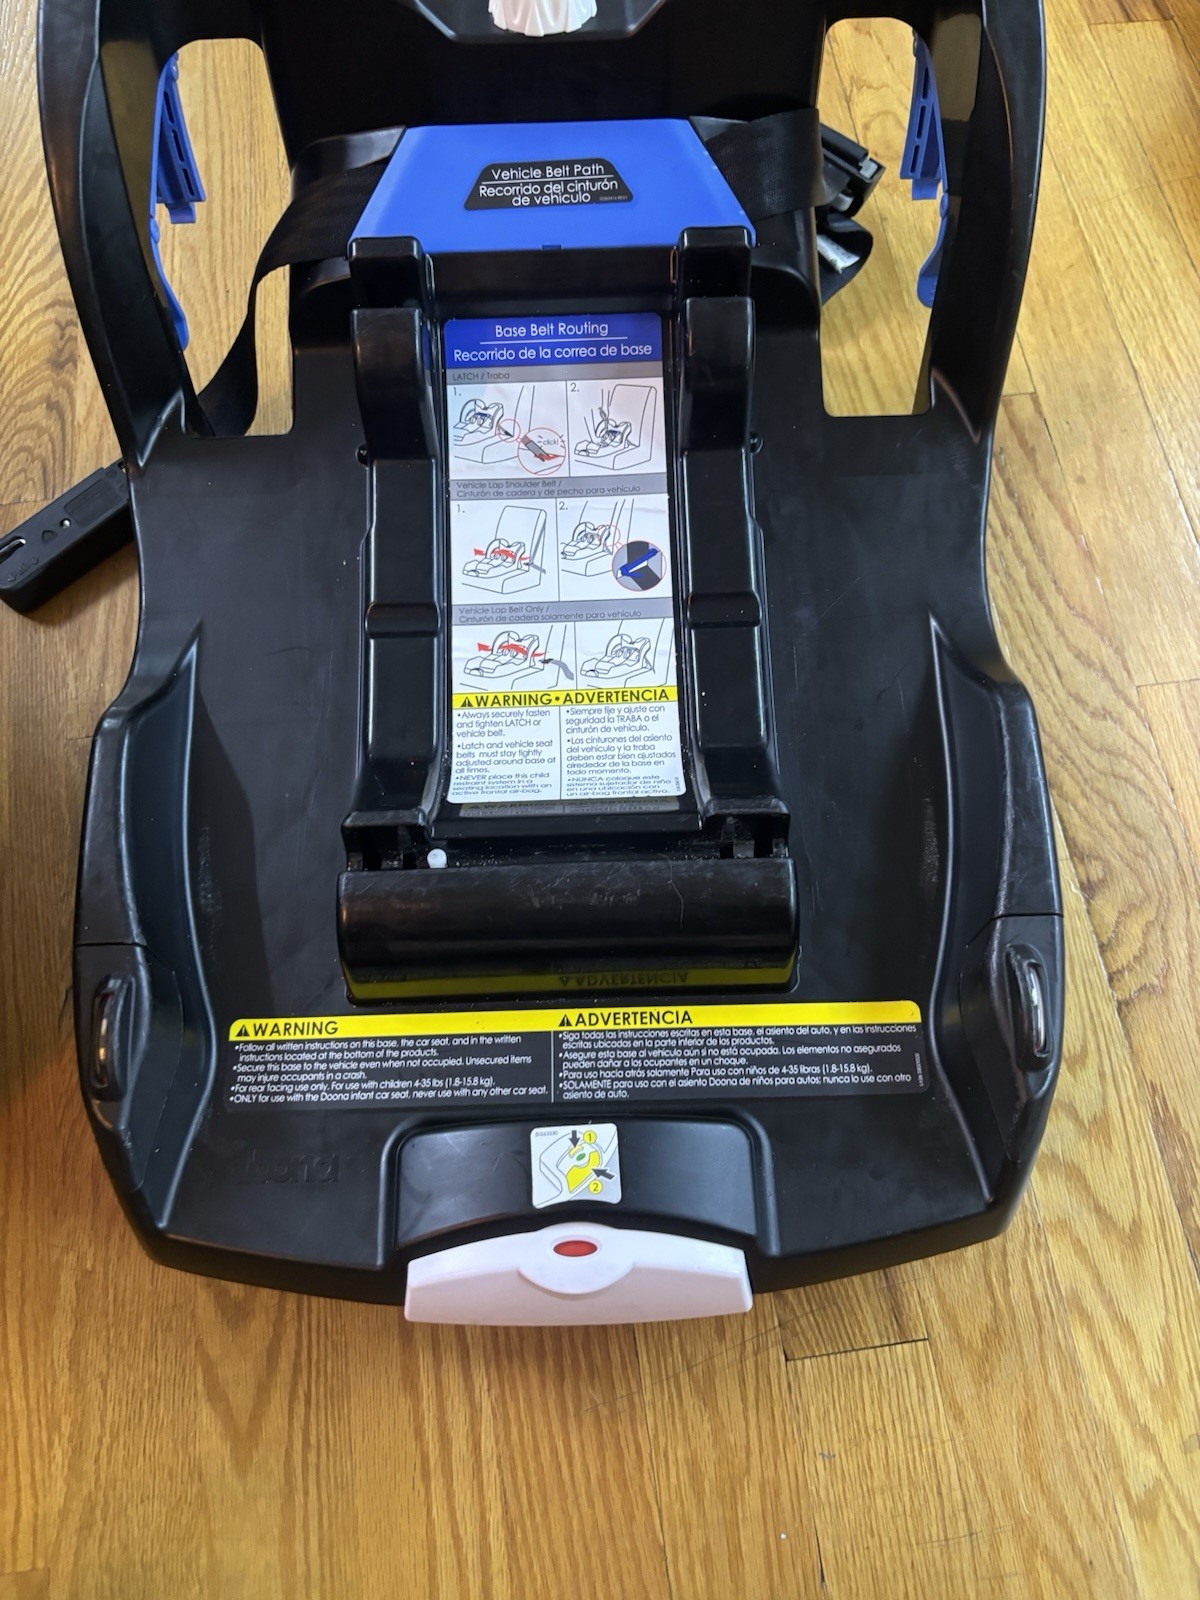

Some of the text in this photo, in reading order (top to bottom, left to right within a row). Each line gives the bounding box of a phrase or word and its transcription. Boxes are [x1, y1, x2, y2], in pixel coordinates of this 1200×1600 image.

[491, 163, 604, 179] Vehicle Belt Path
[479, 178, 617, 197] Recorrido del cinturón
[512, 194, 530, 206] de
[495, 322, 607, 338] Base Belt Routing
[454, 343, 651, 362] Recorrido de la correa de base
[452, 372, 478, 381] LATCH
[486, 371, 509, 380] Traba
[452, 386, 462, 396] 1.
[570, 383, 580, 392] 2.
[456, 504, 465, 514] 1.
[558, 501, 568, 511] 2.
[475, 689, 668, 707] WARNING ADVERTENCIA
[575, 1010, 692, 1026] ADVERTENCIA
[253, 1021, 337, 1037] WARNING
[239, 1043, 264, 1052] Follow
[265, 1043, 275, 1051] all
[276, 1042, 303, 1051] written
[304, 1040, 348, 1050] instructions
[362, 1040, 375, 1048] this
[400, 1038, 414, 1047] the
[452, 1037, 469, 1045] and
[470, 1036, 477, 1045] in
[479, 1036, 492, 1044] the
[494, 1035, 521, 1044] written
[239, 1053, 282, 1062] instructions
[284, 1052, 316, 1061] located
[317, 1052, 327, 1060] at
[328, 1051, 342, 1060] the
[343, 1050, 374, 1059] bottom
[375, 1050, 384, 1058] of
[385, 1049, 399, 1058] the
[237, 1064, 265, 1073] Secure
[266, 1063, 279, 1072] this
[280, 1062, 301, 1071] base
[303, 1062, 312, 1071] to
[313, 1062, 327, 1070] the
[328, 1061, 358, 1070] vehicle
[381, 1059, 405, 1068] when
[406, 1059, 420, 1067] not
[465, 1056, 508, 1065] Unsecured
[510, 1055, 531, 1064] items
[237, 1076, 256, 1084] may
[257, 1073, 279, 1084] injure
[280, 1072, 324, 1083] occupants
[326, 1072, 333, 1080] in
[233, 1094, 256, 1104] ONLY
[258, 1094, 269, 1103] for
[286, 1093, 303, 1102] with
[305, 1093, 319, 1102] the
[320, 1092, 349, 1101] Doona
[350, 1091, 374, 1100] infant
[453, 1088, 470, 1097] with
[471, 1090, 488, 1098] any
[489, 1087, 511, 1096] other
[588, 1133, 592, 1142] 1
[592, 1183, 599, 1192] 2
